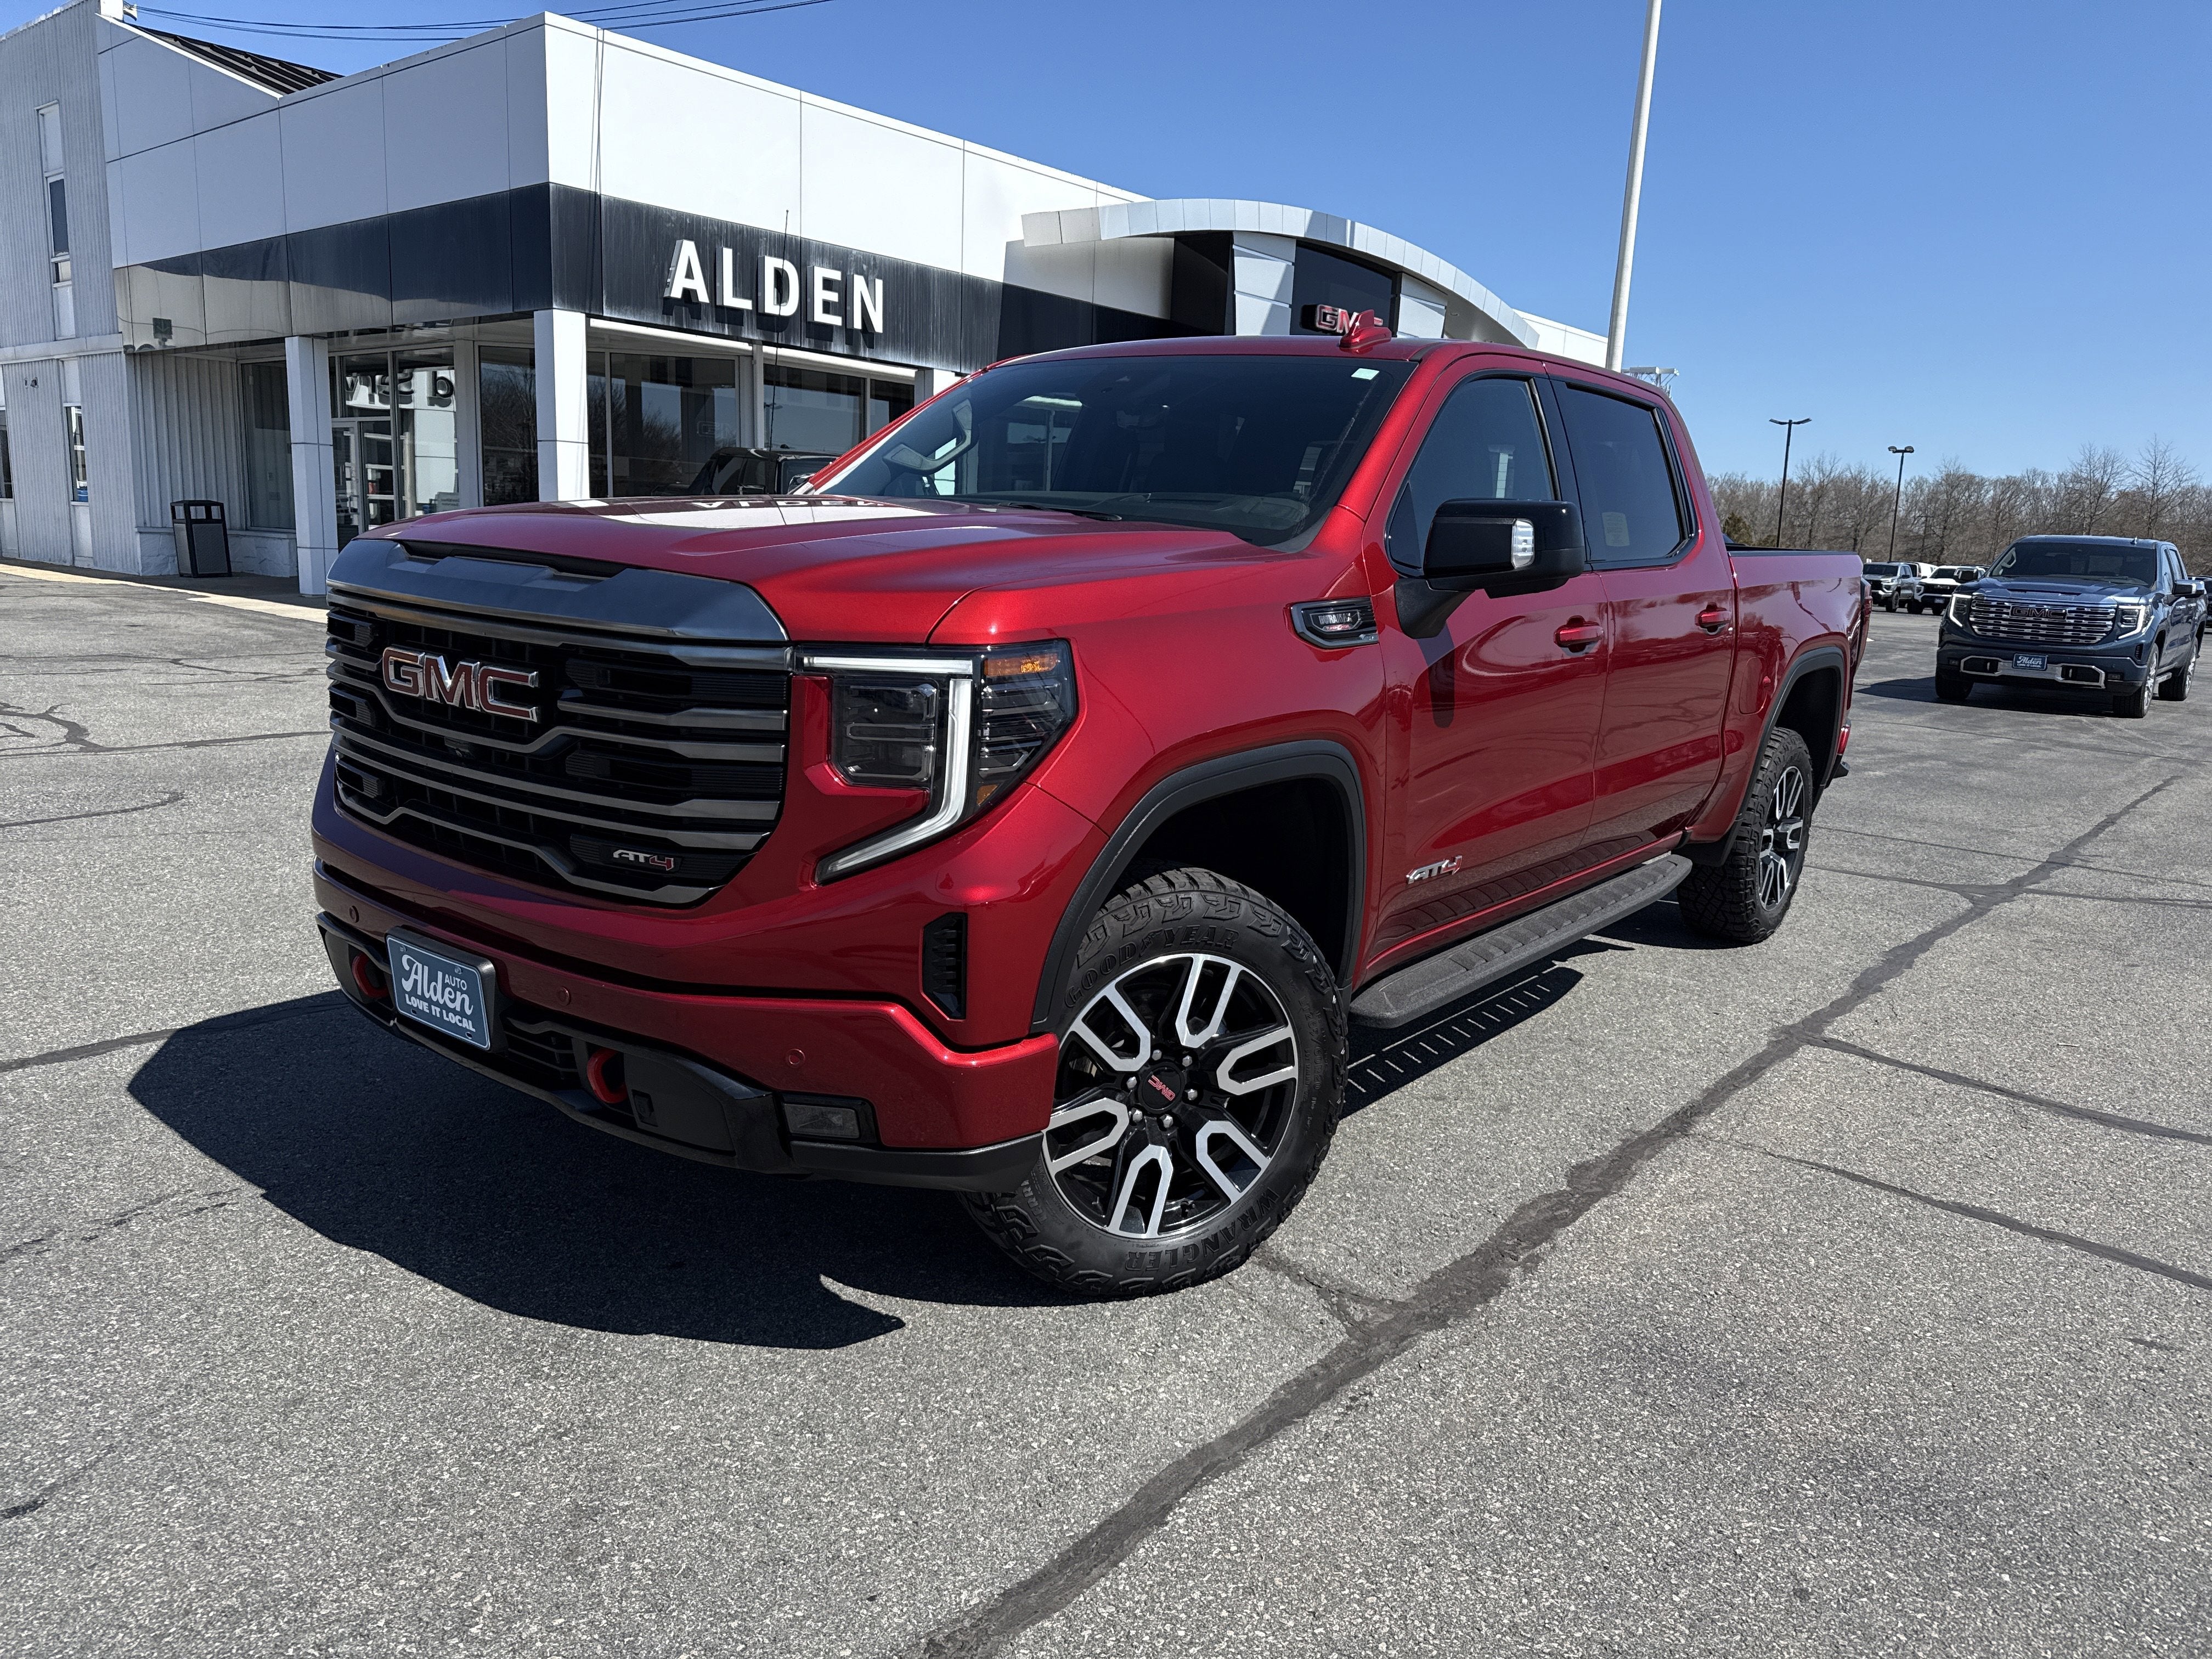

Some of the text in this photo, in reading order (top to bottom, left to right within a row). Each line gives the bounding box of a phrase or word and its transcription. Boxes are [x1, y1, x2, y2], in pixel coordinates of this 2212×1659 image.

[665, 239, 883, 334] ALDEN
[2013, 607, 2065, 619] GMC
[2017, 656, 2042, 665] Alden
[382, 646, 539, 723] GMC
[613, 849, 674, 871] AT4
[1406, 855, 1463, 885] AT4
[402, 954, 473, 1015] Alden
[444, 974, 467, 991] AUTO
[405, 994, 476, 1032] LOVE IT LOCAL
[1148, 1075, 1176, 1101] GMC
[1126, 1187, 1280, 1271] WRANGLER
